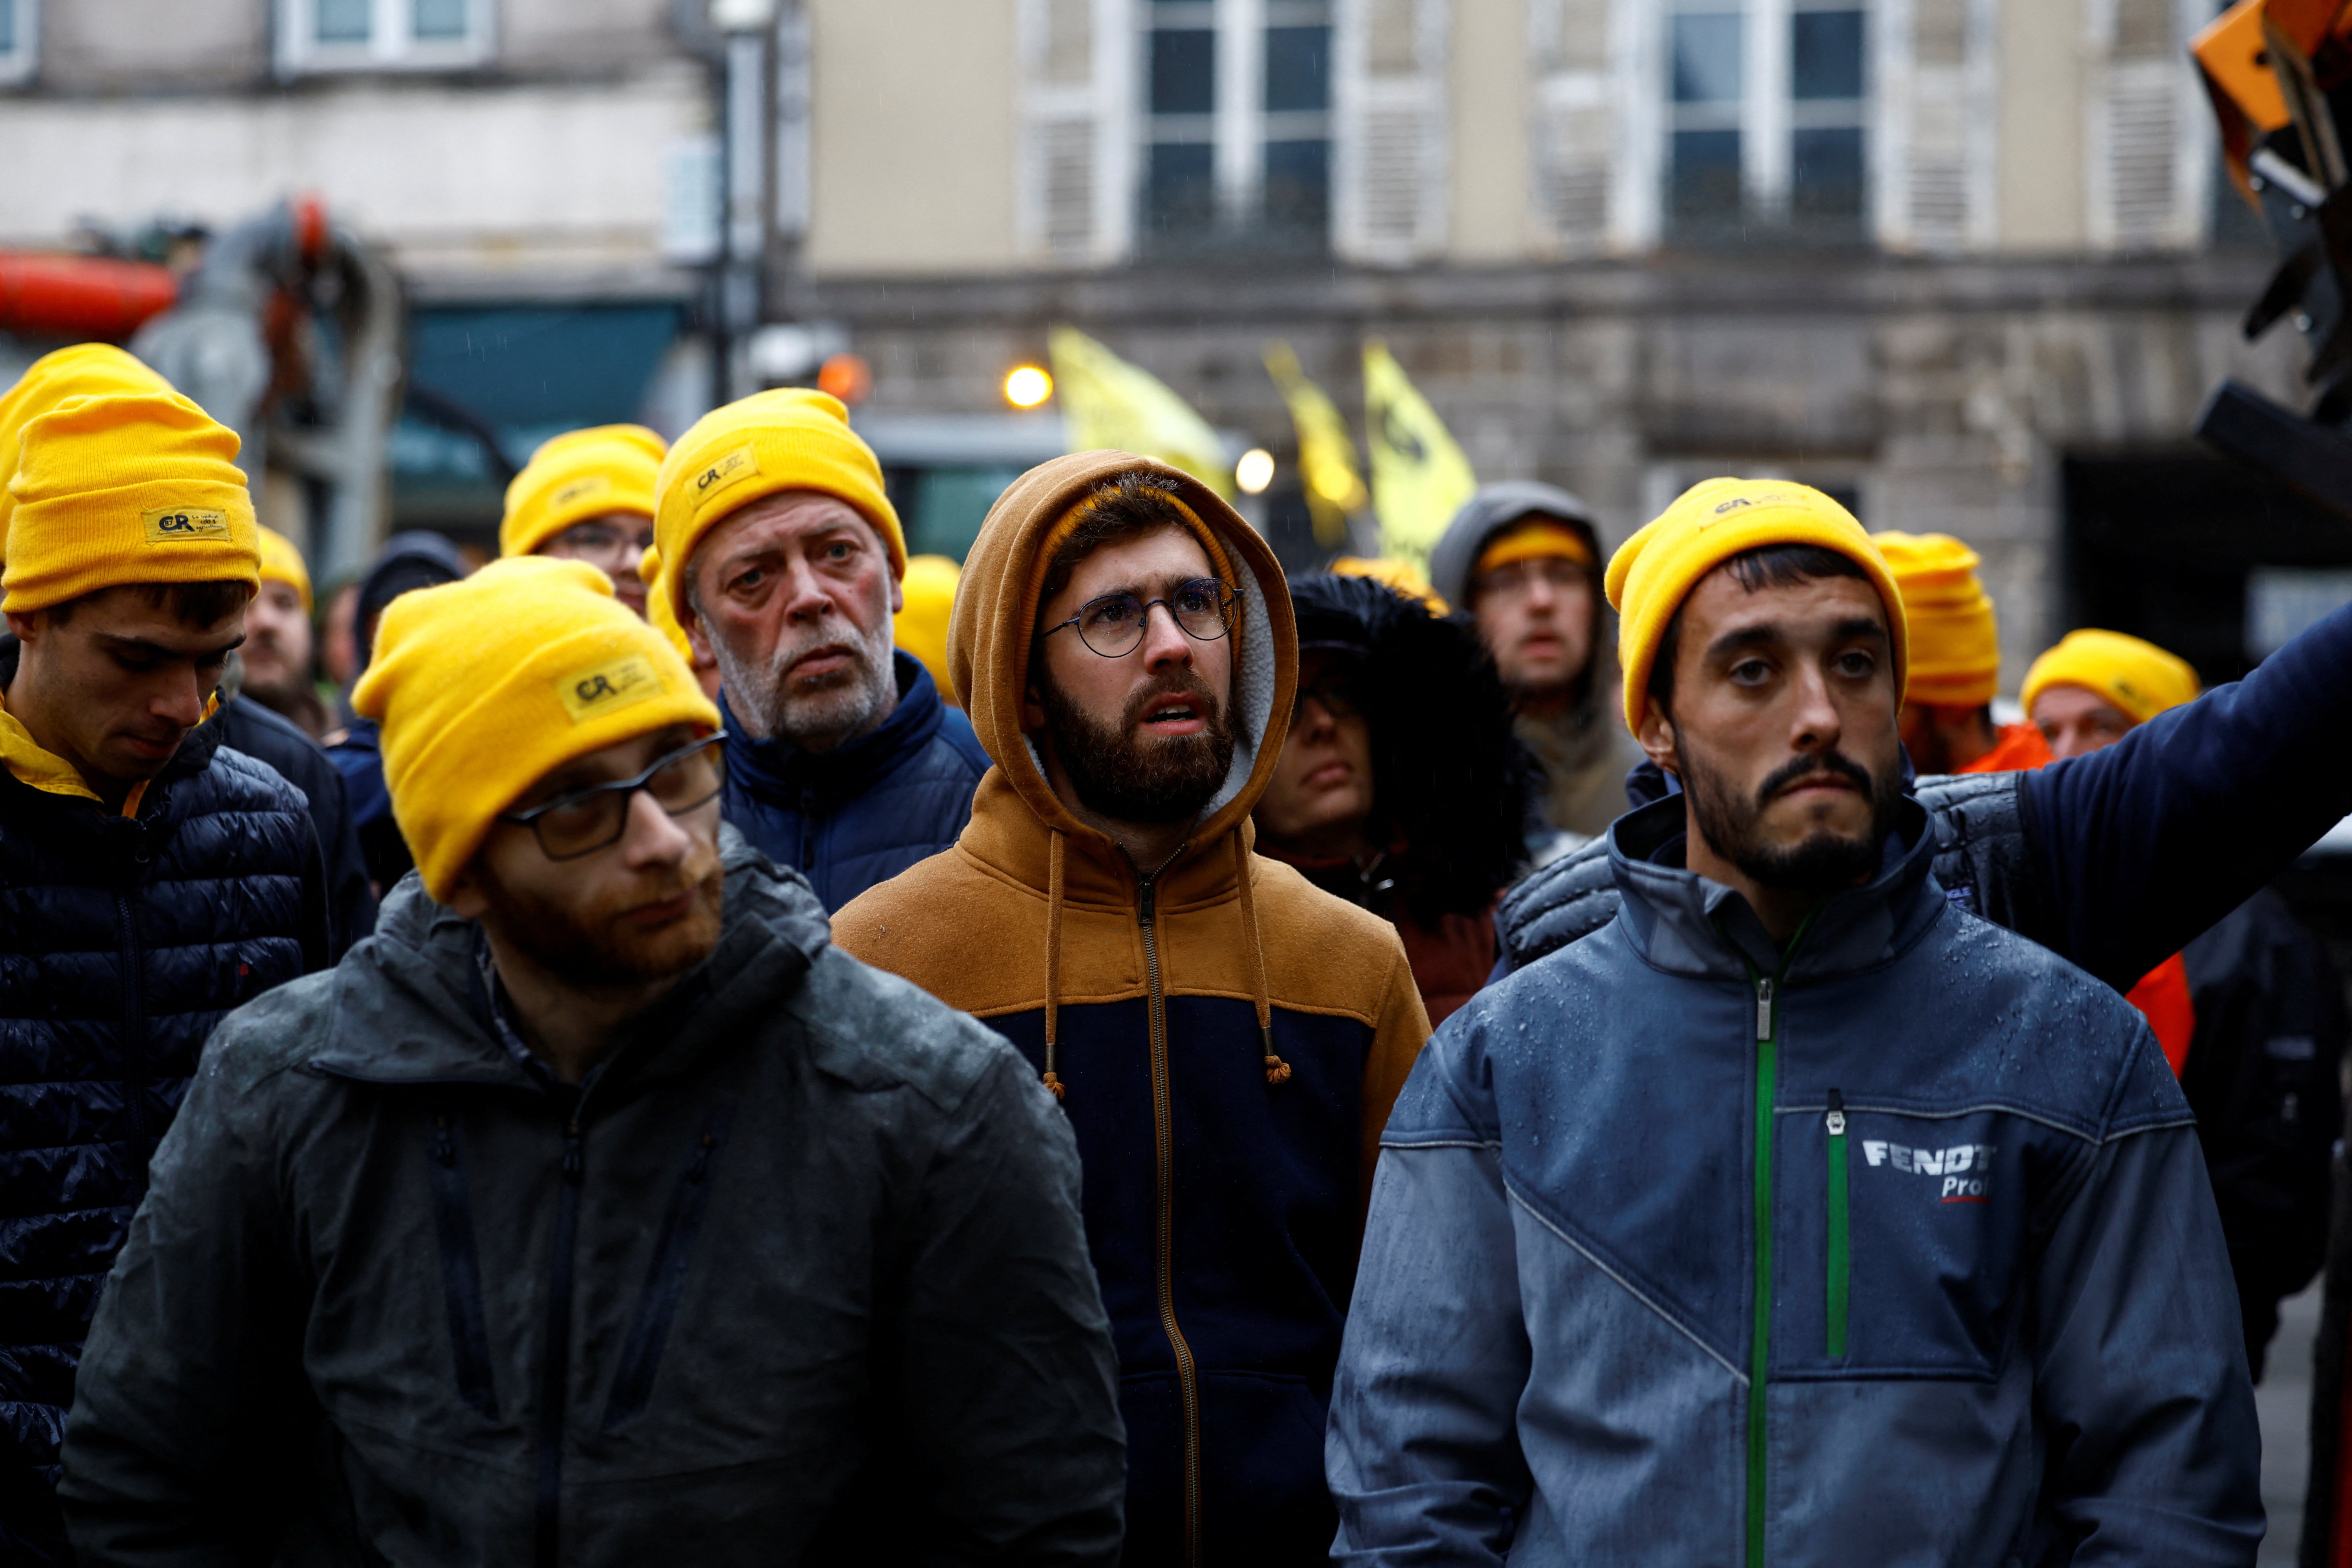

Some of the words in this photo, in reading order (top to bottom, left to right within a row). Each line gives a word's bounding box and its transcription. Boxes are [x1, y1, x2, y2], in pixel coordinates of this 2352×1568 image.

[698, 469, 721, 488] CR
[159, 515, 196, 531] CR
[576, 674, 617, 703] CR
[1862, 1140, 1997, 1176] FENDT
